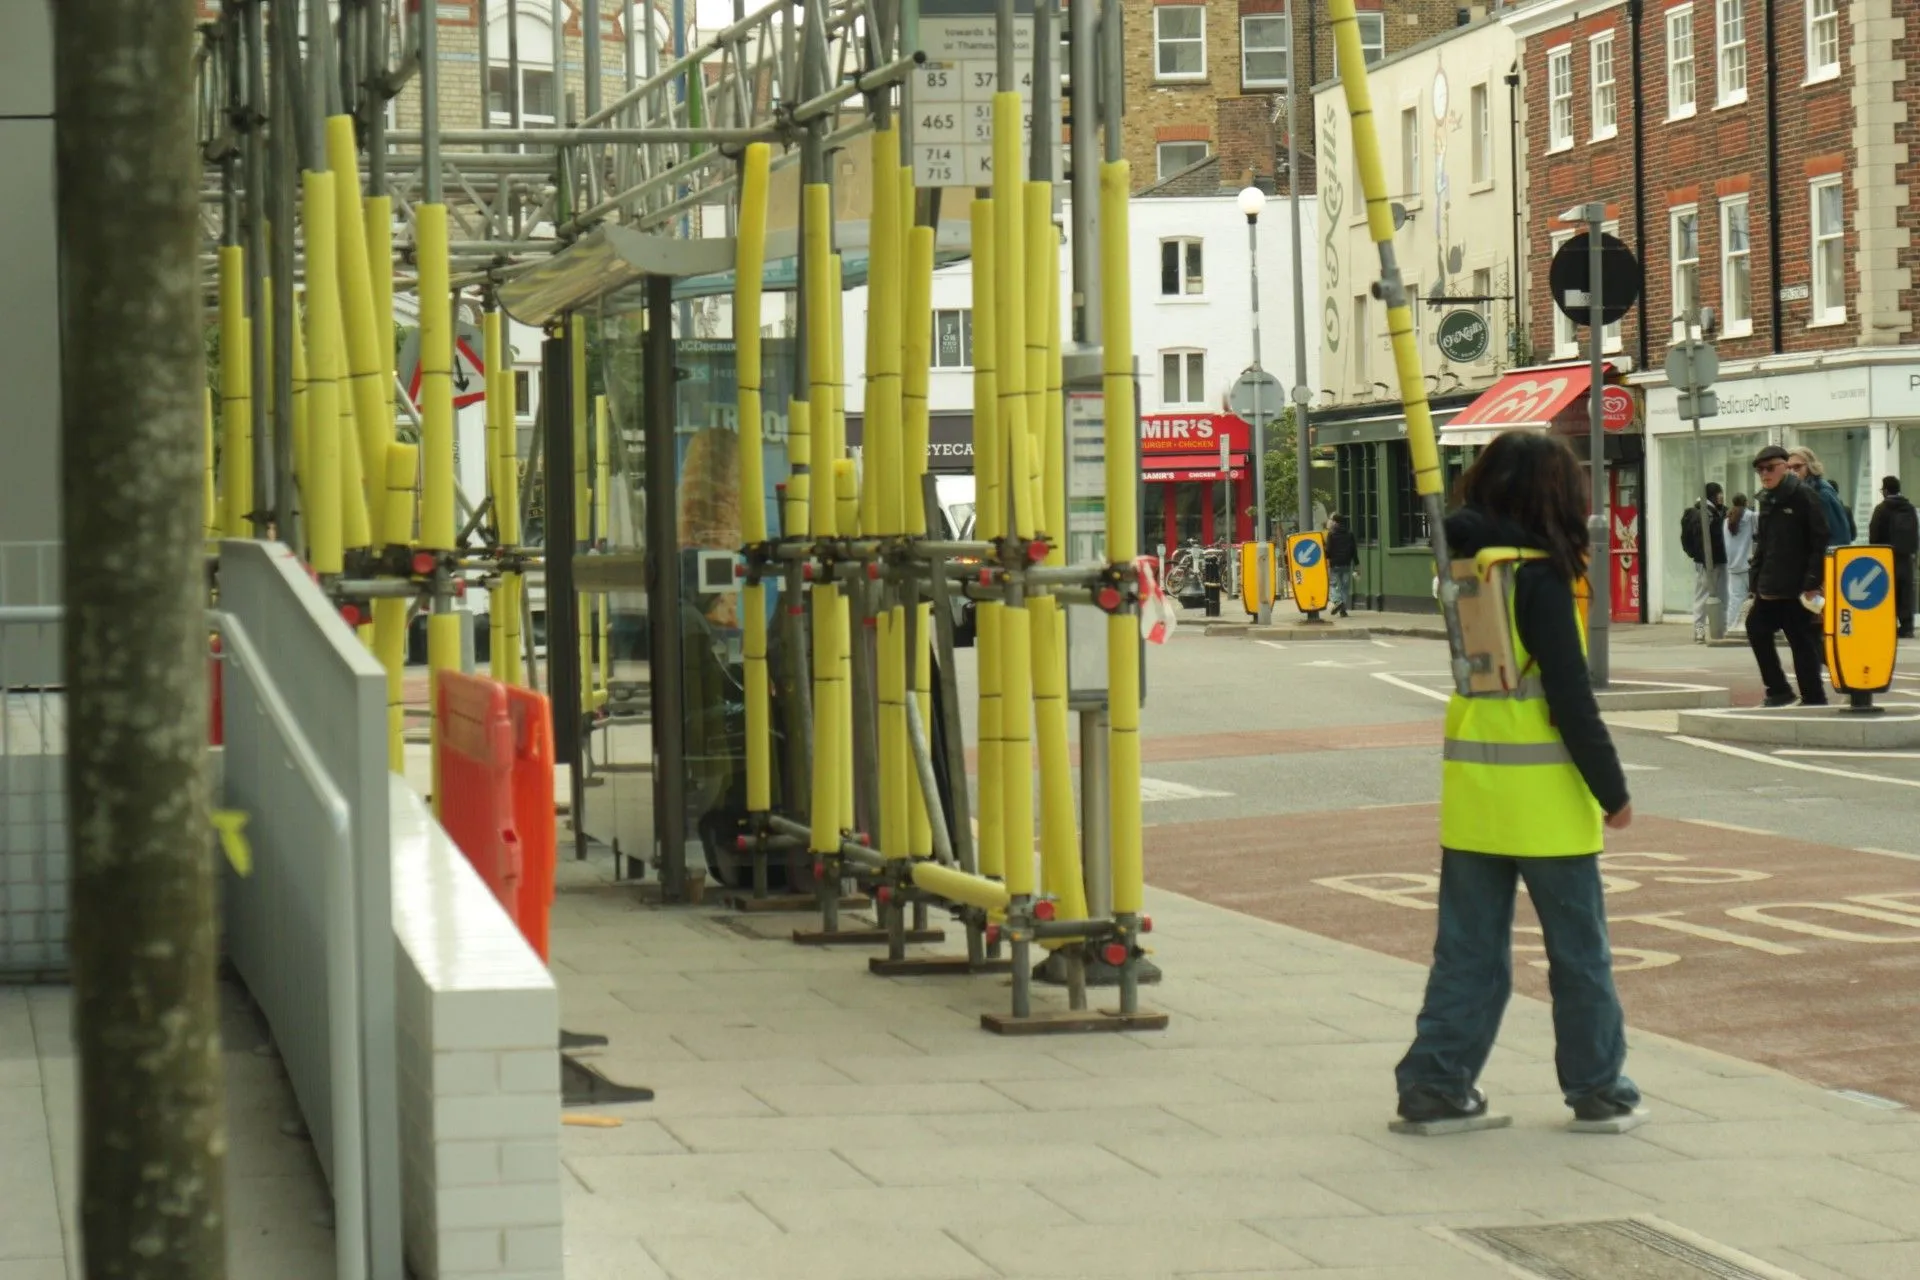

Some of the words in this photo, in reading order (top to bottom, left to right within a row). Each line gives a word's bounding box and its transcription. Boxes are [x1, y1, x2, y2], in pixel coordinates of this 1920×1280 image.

[926, 73, 948, 87] 85
[974, 72, 998, 87] 37
[975, 106, 990, 118] 51
[922, 114, 954, 129] 465
[926, 148, 952, 161] 714
[928, 167, 952, 180] 715
[679, 340, 737, 352] JCDecaux
[1910, 374, 1920, 392] P
[1141, 418, 1214, 439] MIR'S
[927, 443, 975, 456] YECA
[1142, 440, 1172, 449] URGER
[1179, 440, 1214, 448] CHICKEN
[1188, 471, 1216, 479] CHICKEN
